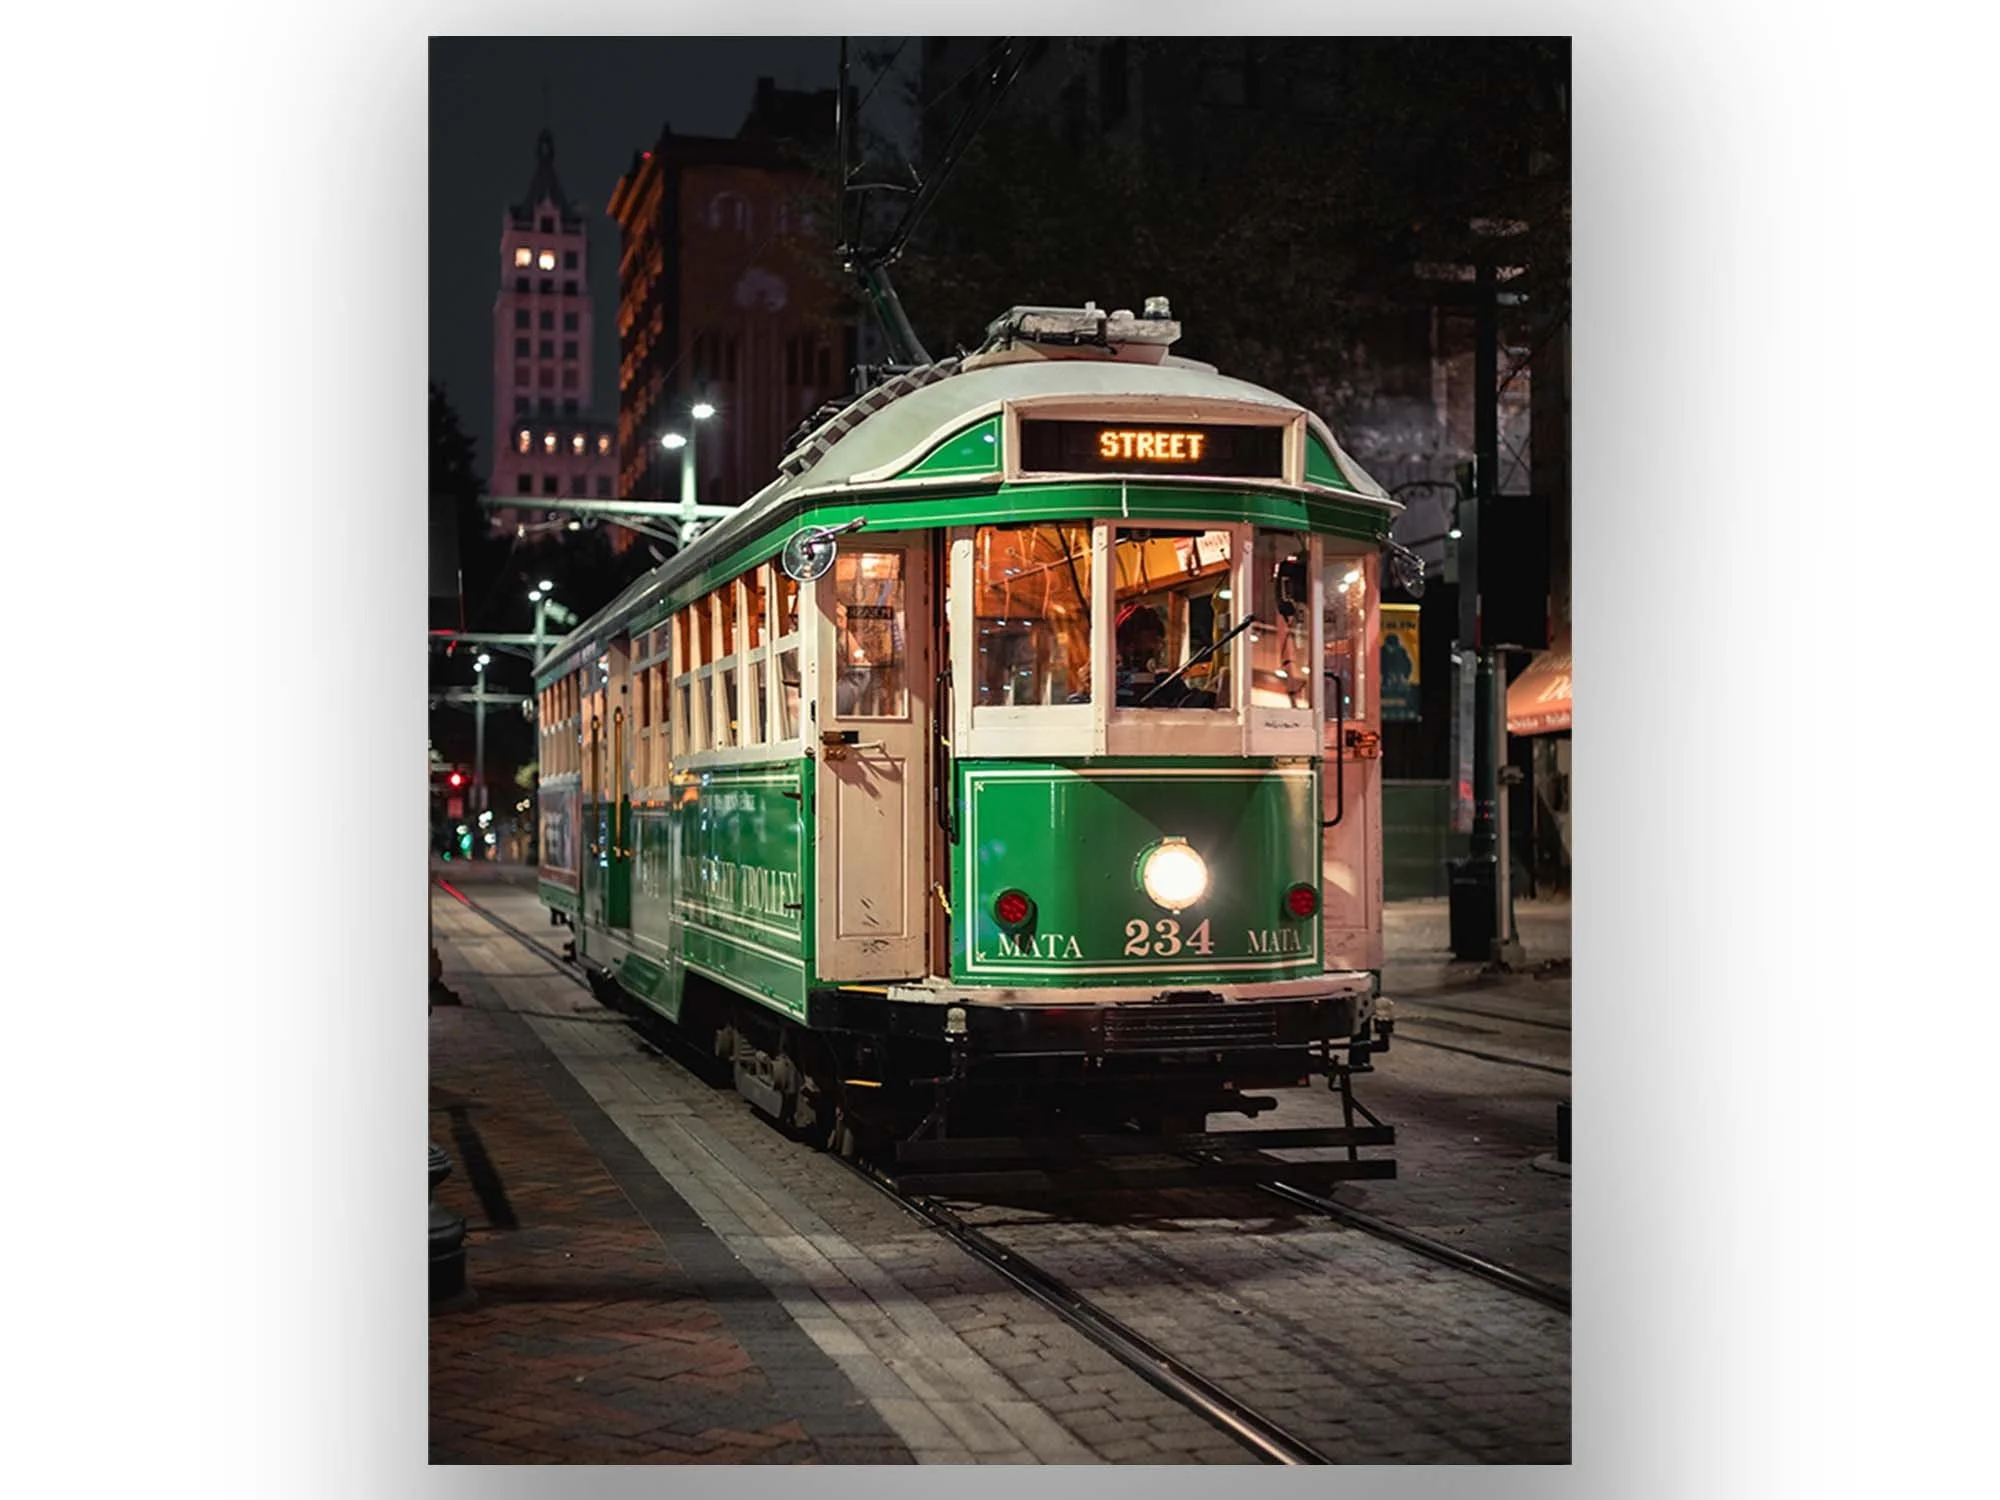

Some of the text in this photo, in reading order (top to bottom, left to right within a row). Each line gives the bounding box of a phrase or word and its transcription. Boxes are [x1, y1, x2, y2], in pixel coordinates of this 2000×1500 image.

[1100, 431, 1203, 459] STREET
[740, 864, 797, 919] TROLLEY
[998, 932, 1083, 958] MATA
[1124, 918, 1215, 957] 234
[1247, 928, 1301, 953] MATA
